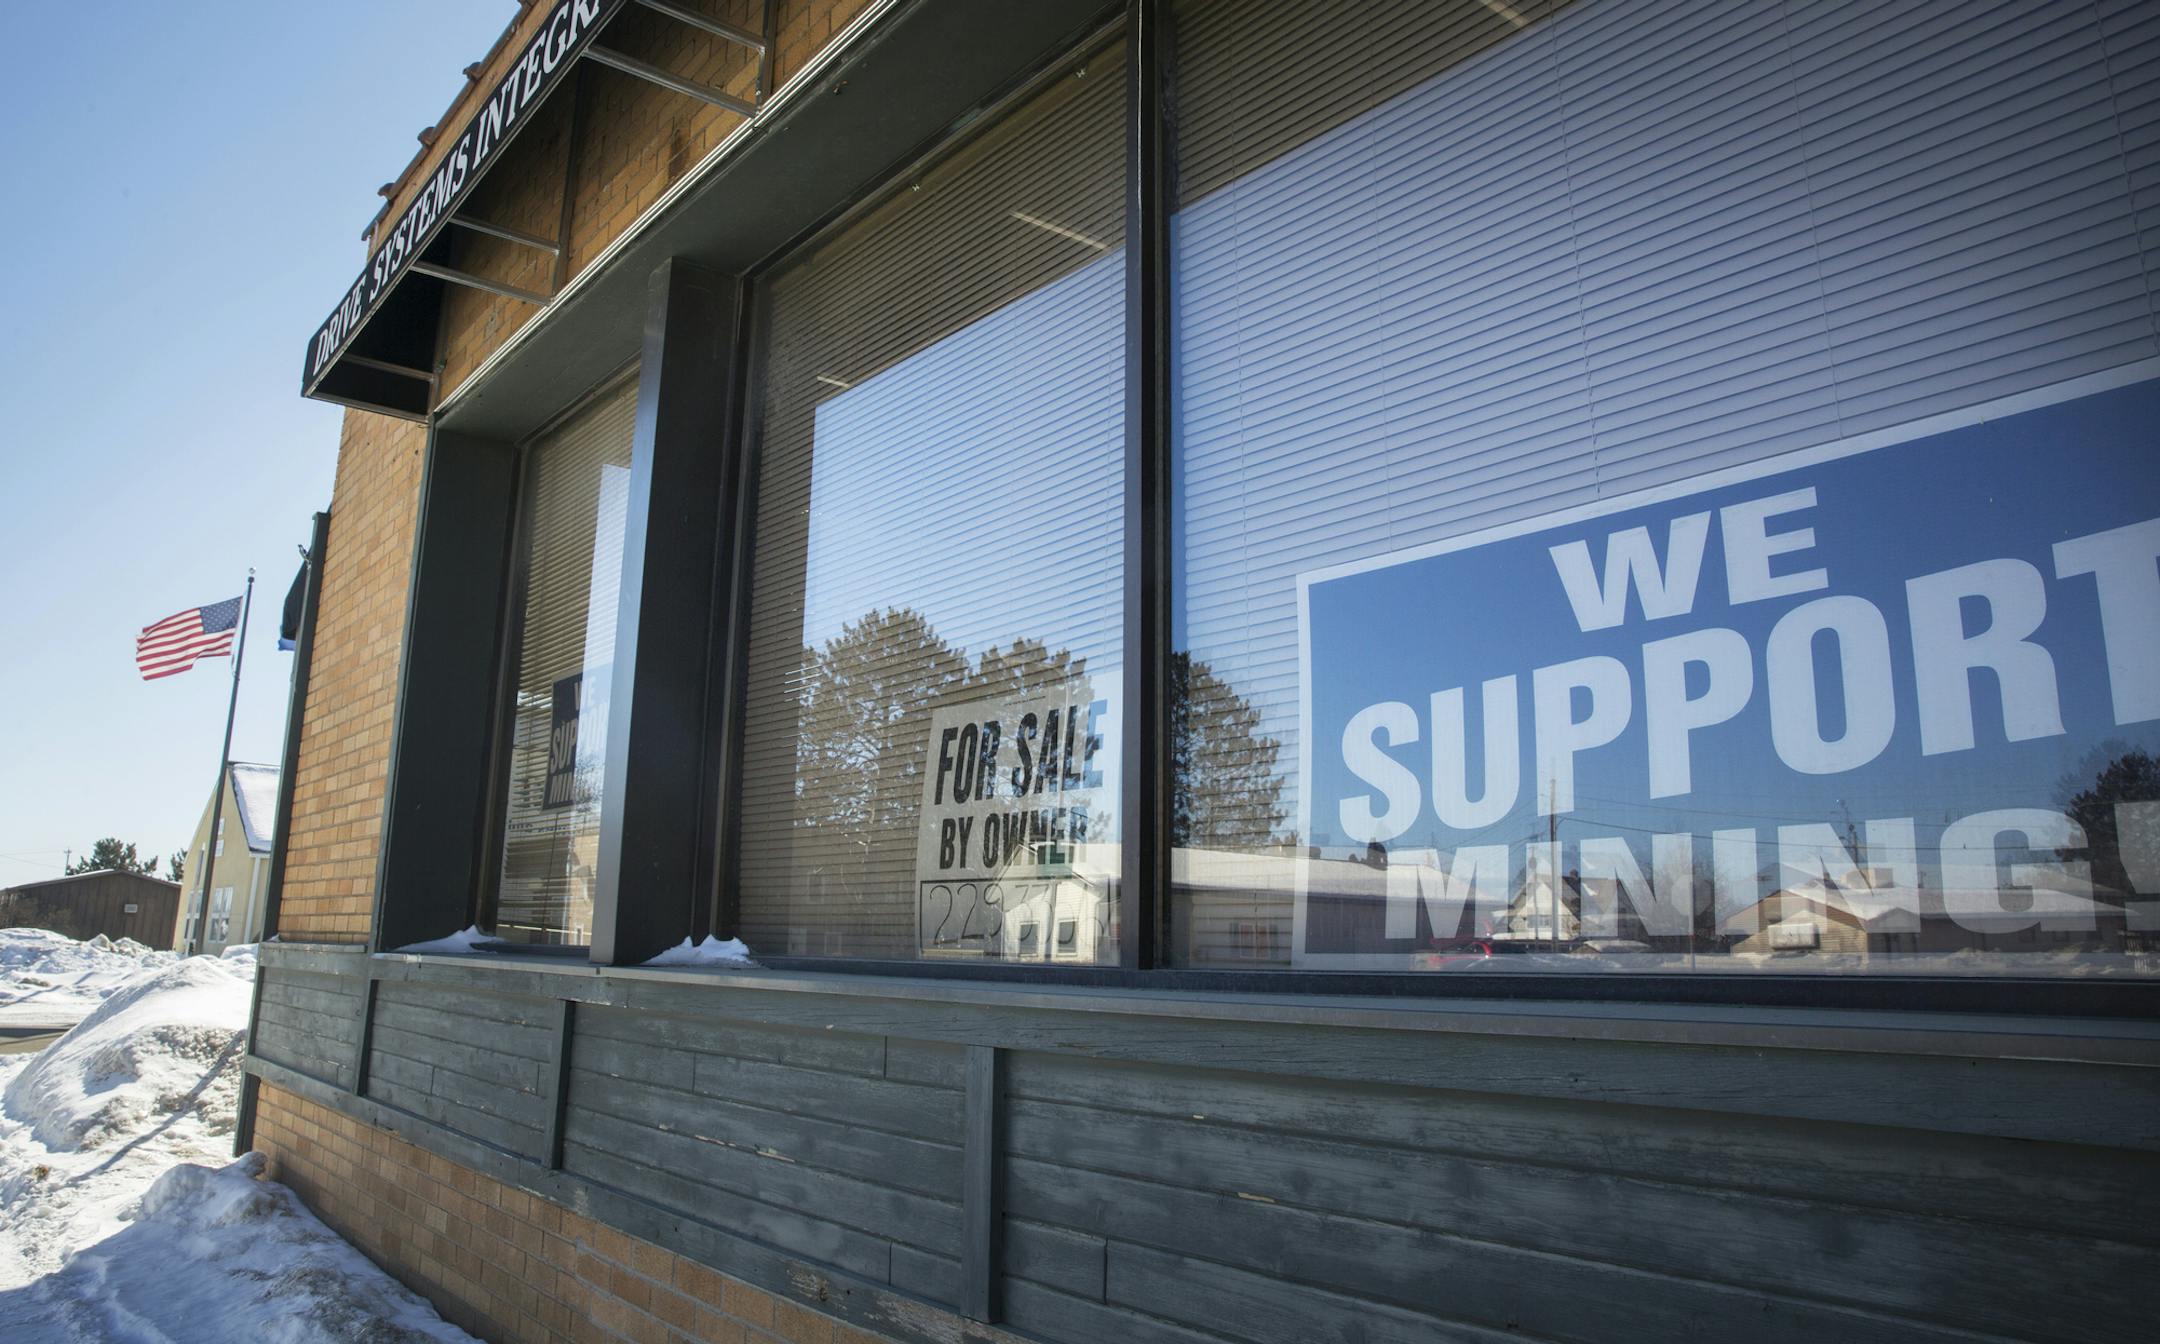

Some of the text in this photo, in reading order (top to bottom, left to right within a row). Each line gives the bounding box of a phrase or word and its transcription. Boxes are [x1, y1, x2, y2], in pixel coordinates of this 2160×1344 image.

[313, 0, 600, 376] DRIVE SYSTEMS INTEGR
[1549, 486, 1830, 632] WE
[934, 699, 1108, 805] FOR SALE
[1339, 517, 2160, 843] SUPPORT
[940, 806, 1089, 870] BY OWNER
